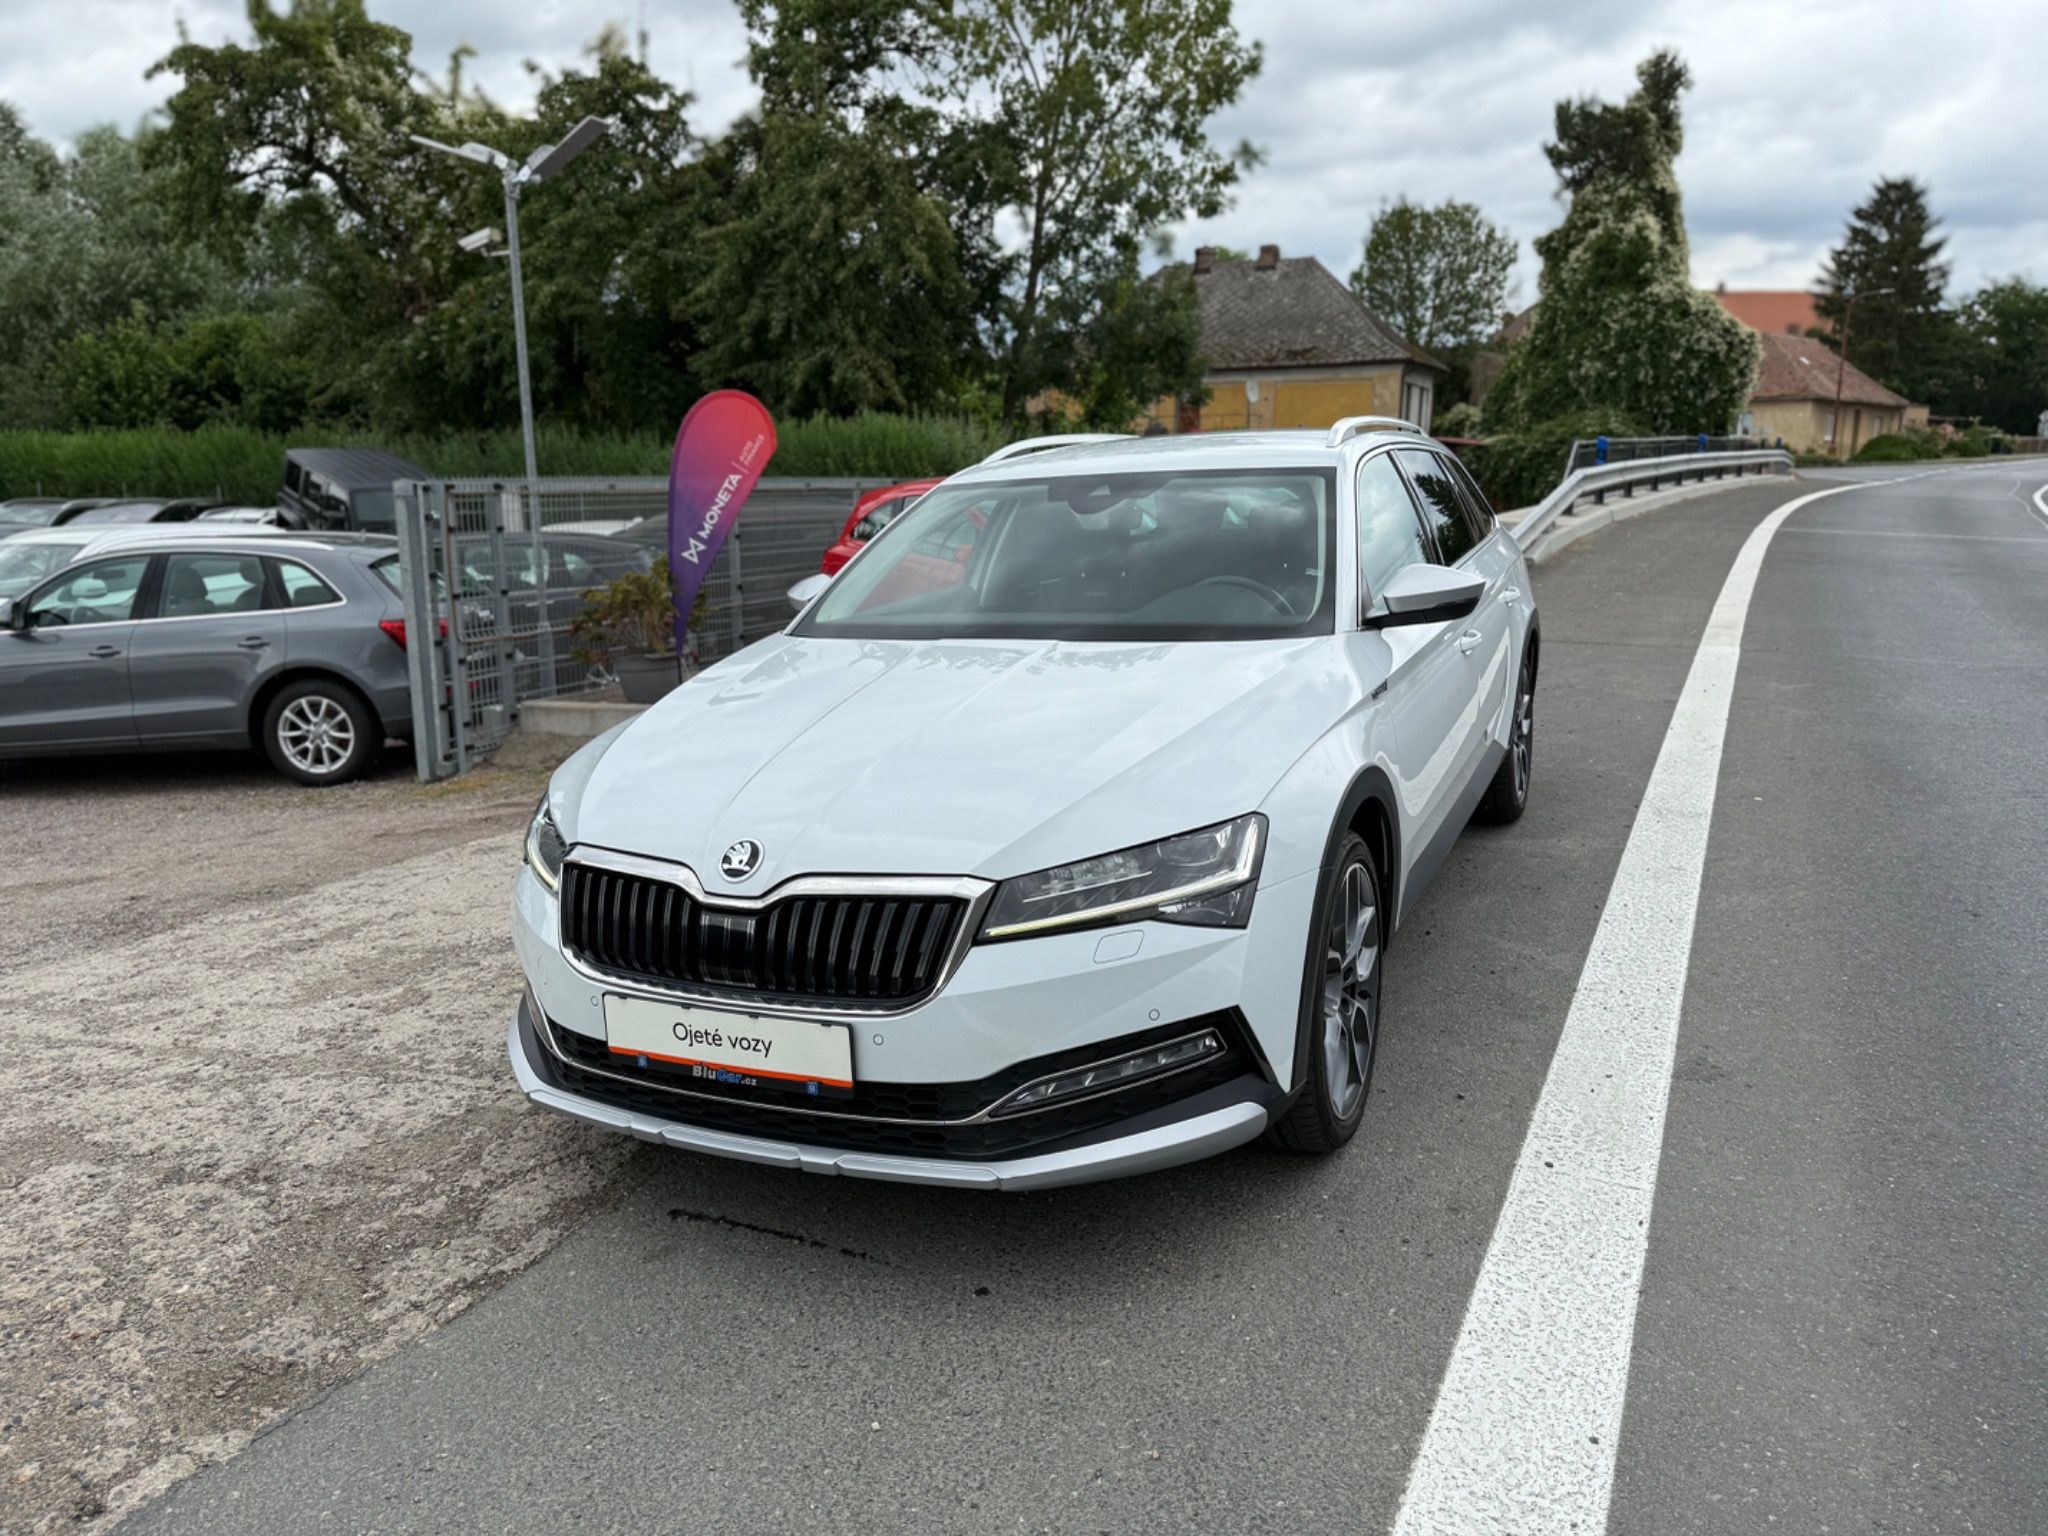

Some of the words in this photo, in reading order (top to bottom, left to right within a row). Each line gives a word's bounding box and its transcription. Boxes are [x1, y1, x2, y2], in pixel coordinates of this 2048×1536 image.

[698, 473, 743, 540] MONETA
[672, 1022, 722, 1047] Ojeté
[727, 1034, 772, 1058] vozy
